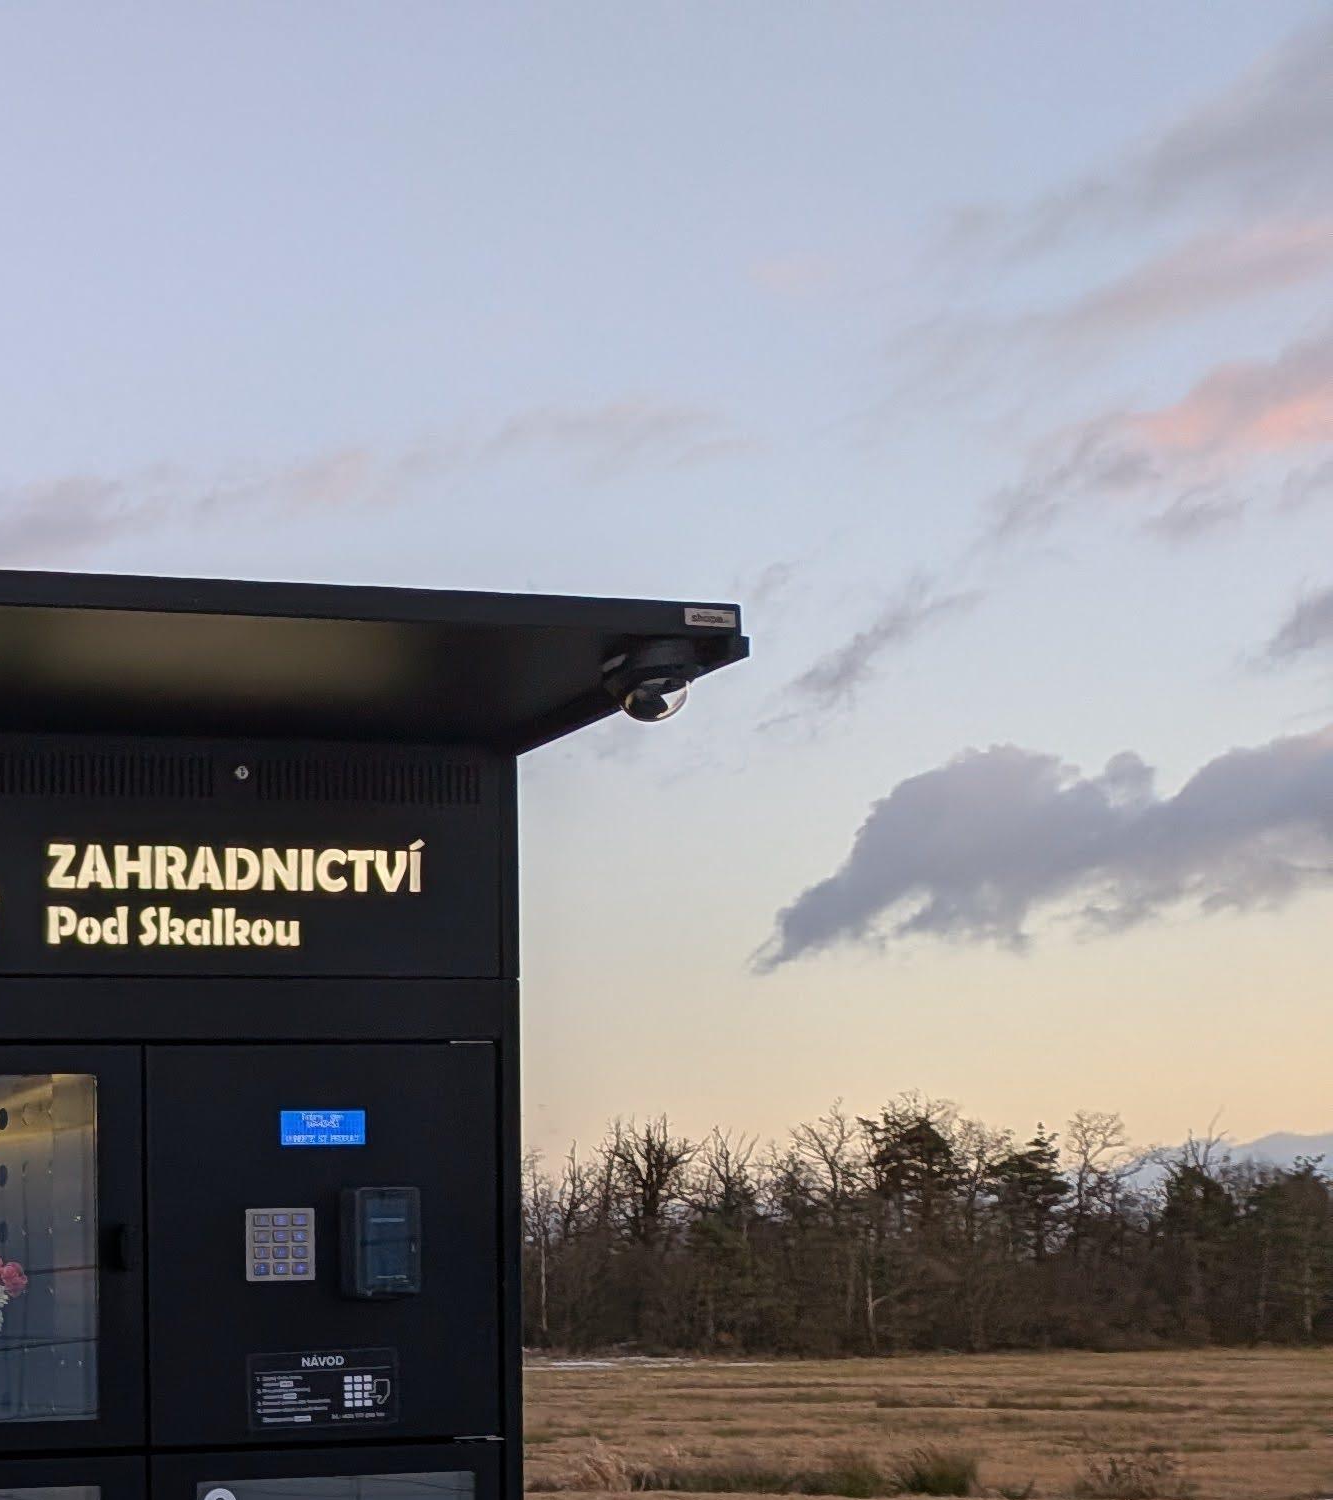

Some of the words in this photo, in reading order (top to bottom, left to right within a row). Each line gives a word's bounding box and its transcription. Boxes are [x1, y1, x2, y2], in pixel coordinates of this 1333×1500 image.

[47, 838, 425, 893] ZAHRADNICTVÍ
[47, 905, 129, 945] Pod
[138, 906, 300, 947] Skalkou
[301, 1354, 345, 1368] NÁVOD
